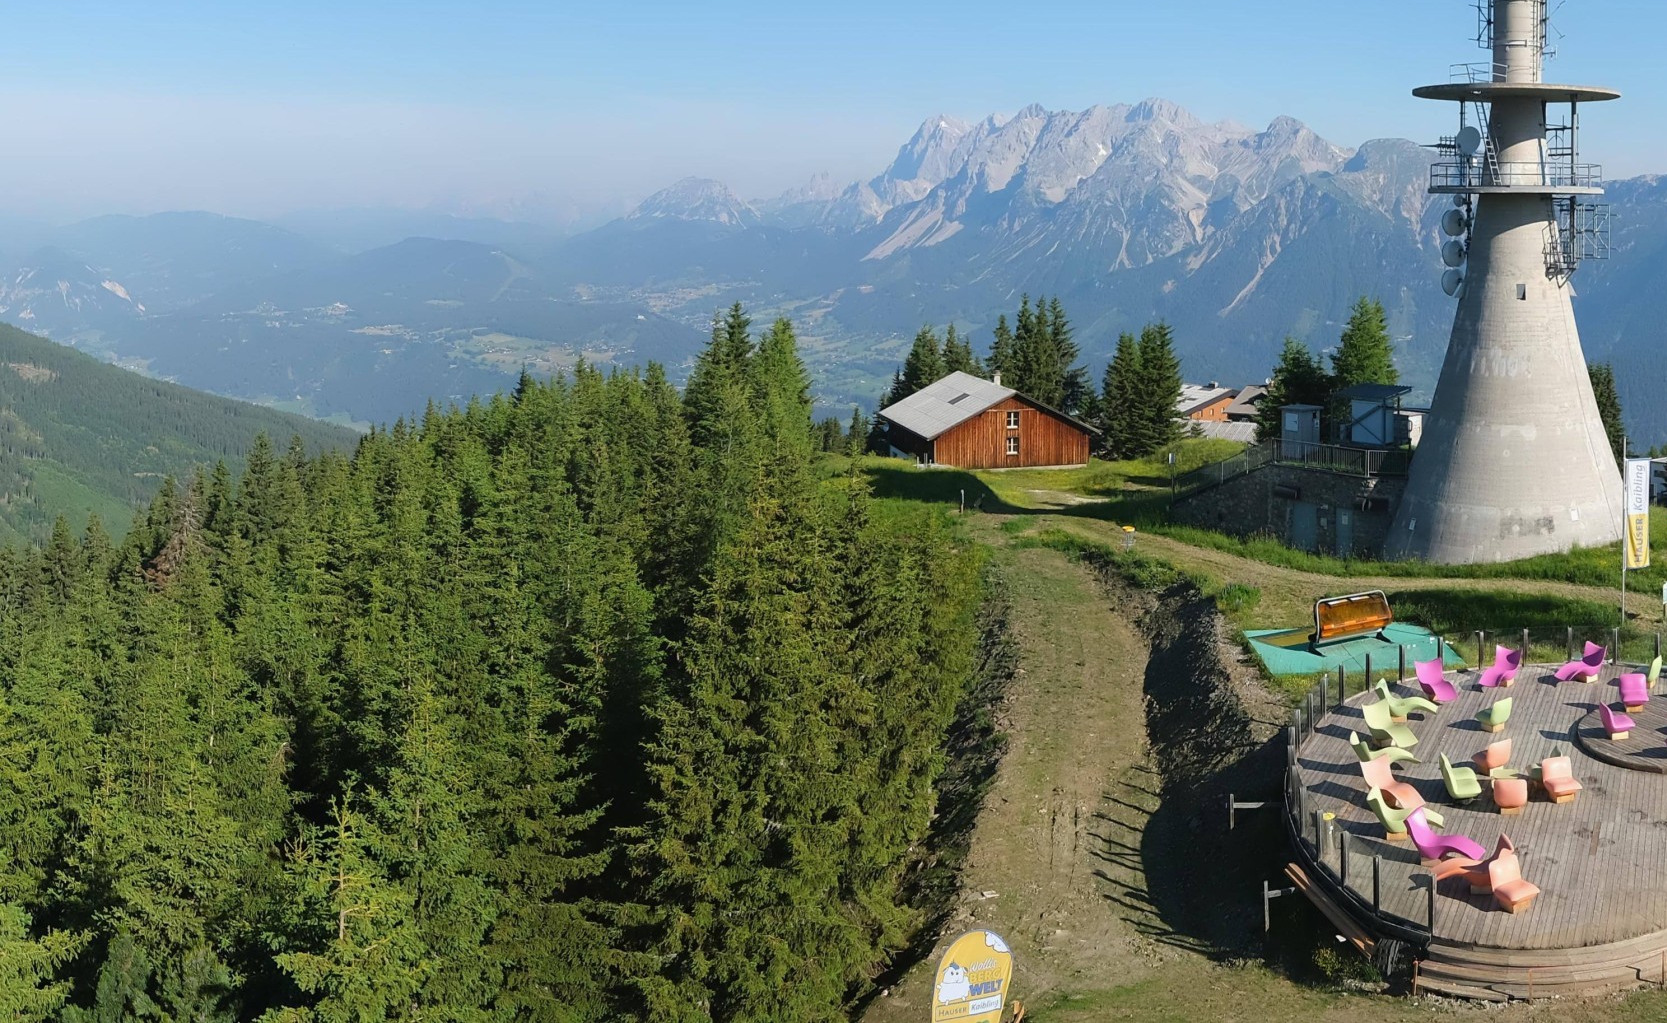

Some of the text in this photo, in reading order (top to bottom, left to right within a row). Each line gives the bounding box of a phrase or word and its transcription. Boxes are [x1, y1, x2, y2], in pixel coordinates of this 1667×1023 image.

[1633, 464, 1646, 510] Kaibling
[969, 967, 1001, 984] BERG
[969, 979, 1004, 997] WELT
[938, 999, 999, 1017] HAUSER Kaibling
